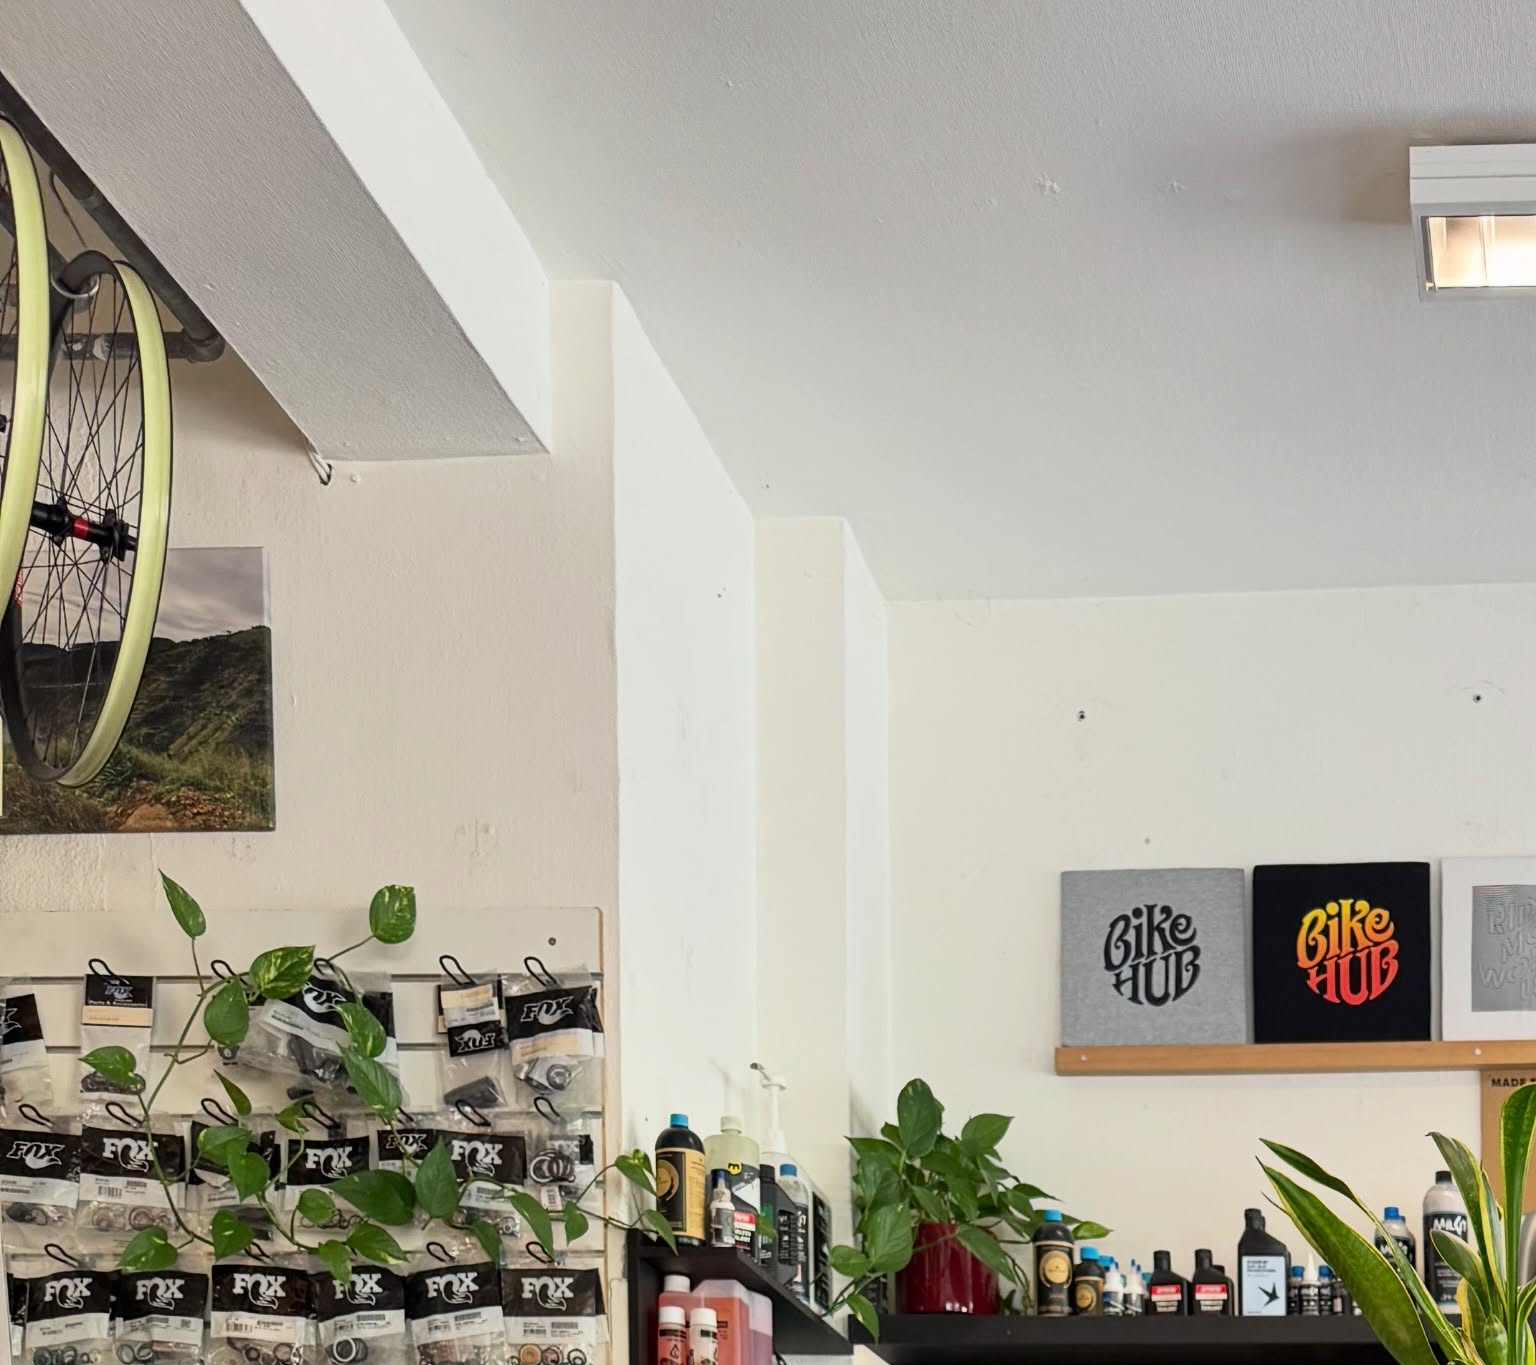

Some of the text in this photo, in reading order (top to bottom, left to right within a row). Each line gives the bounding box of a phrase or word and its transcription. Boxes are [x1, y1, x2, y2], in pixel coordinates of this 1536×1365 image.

[1112, 944, 1201, 1007] HUB
[1306, 939, 1399, 1006] HUB
[520, 996, 575, 1026] FOX
[457, 1028, 497, 1052] FOX
[1491, 1078, 1526, 1088] MADE
[6, 1141, 65, 1169] FOX
[103, 1137, 159, 1173] FOX
[306, 1146, 353, 1179] FOX
[451, 1139, 502, 1177] FOX
[44, 1277, 93, 1310] FOX
[136, 1277, 185, 1310] FOX
[233, 1273, 287, 1310] FOX
[426, 1272, 479, 1305] FOX
[521, 1277, 574, 1310] FOX
